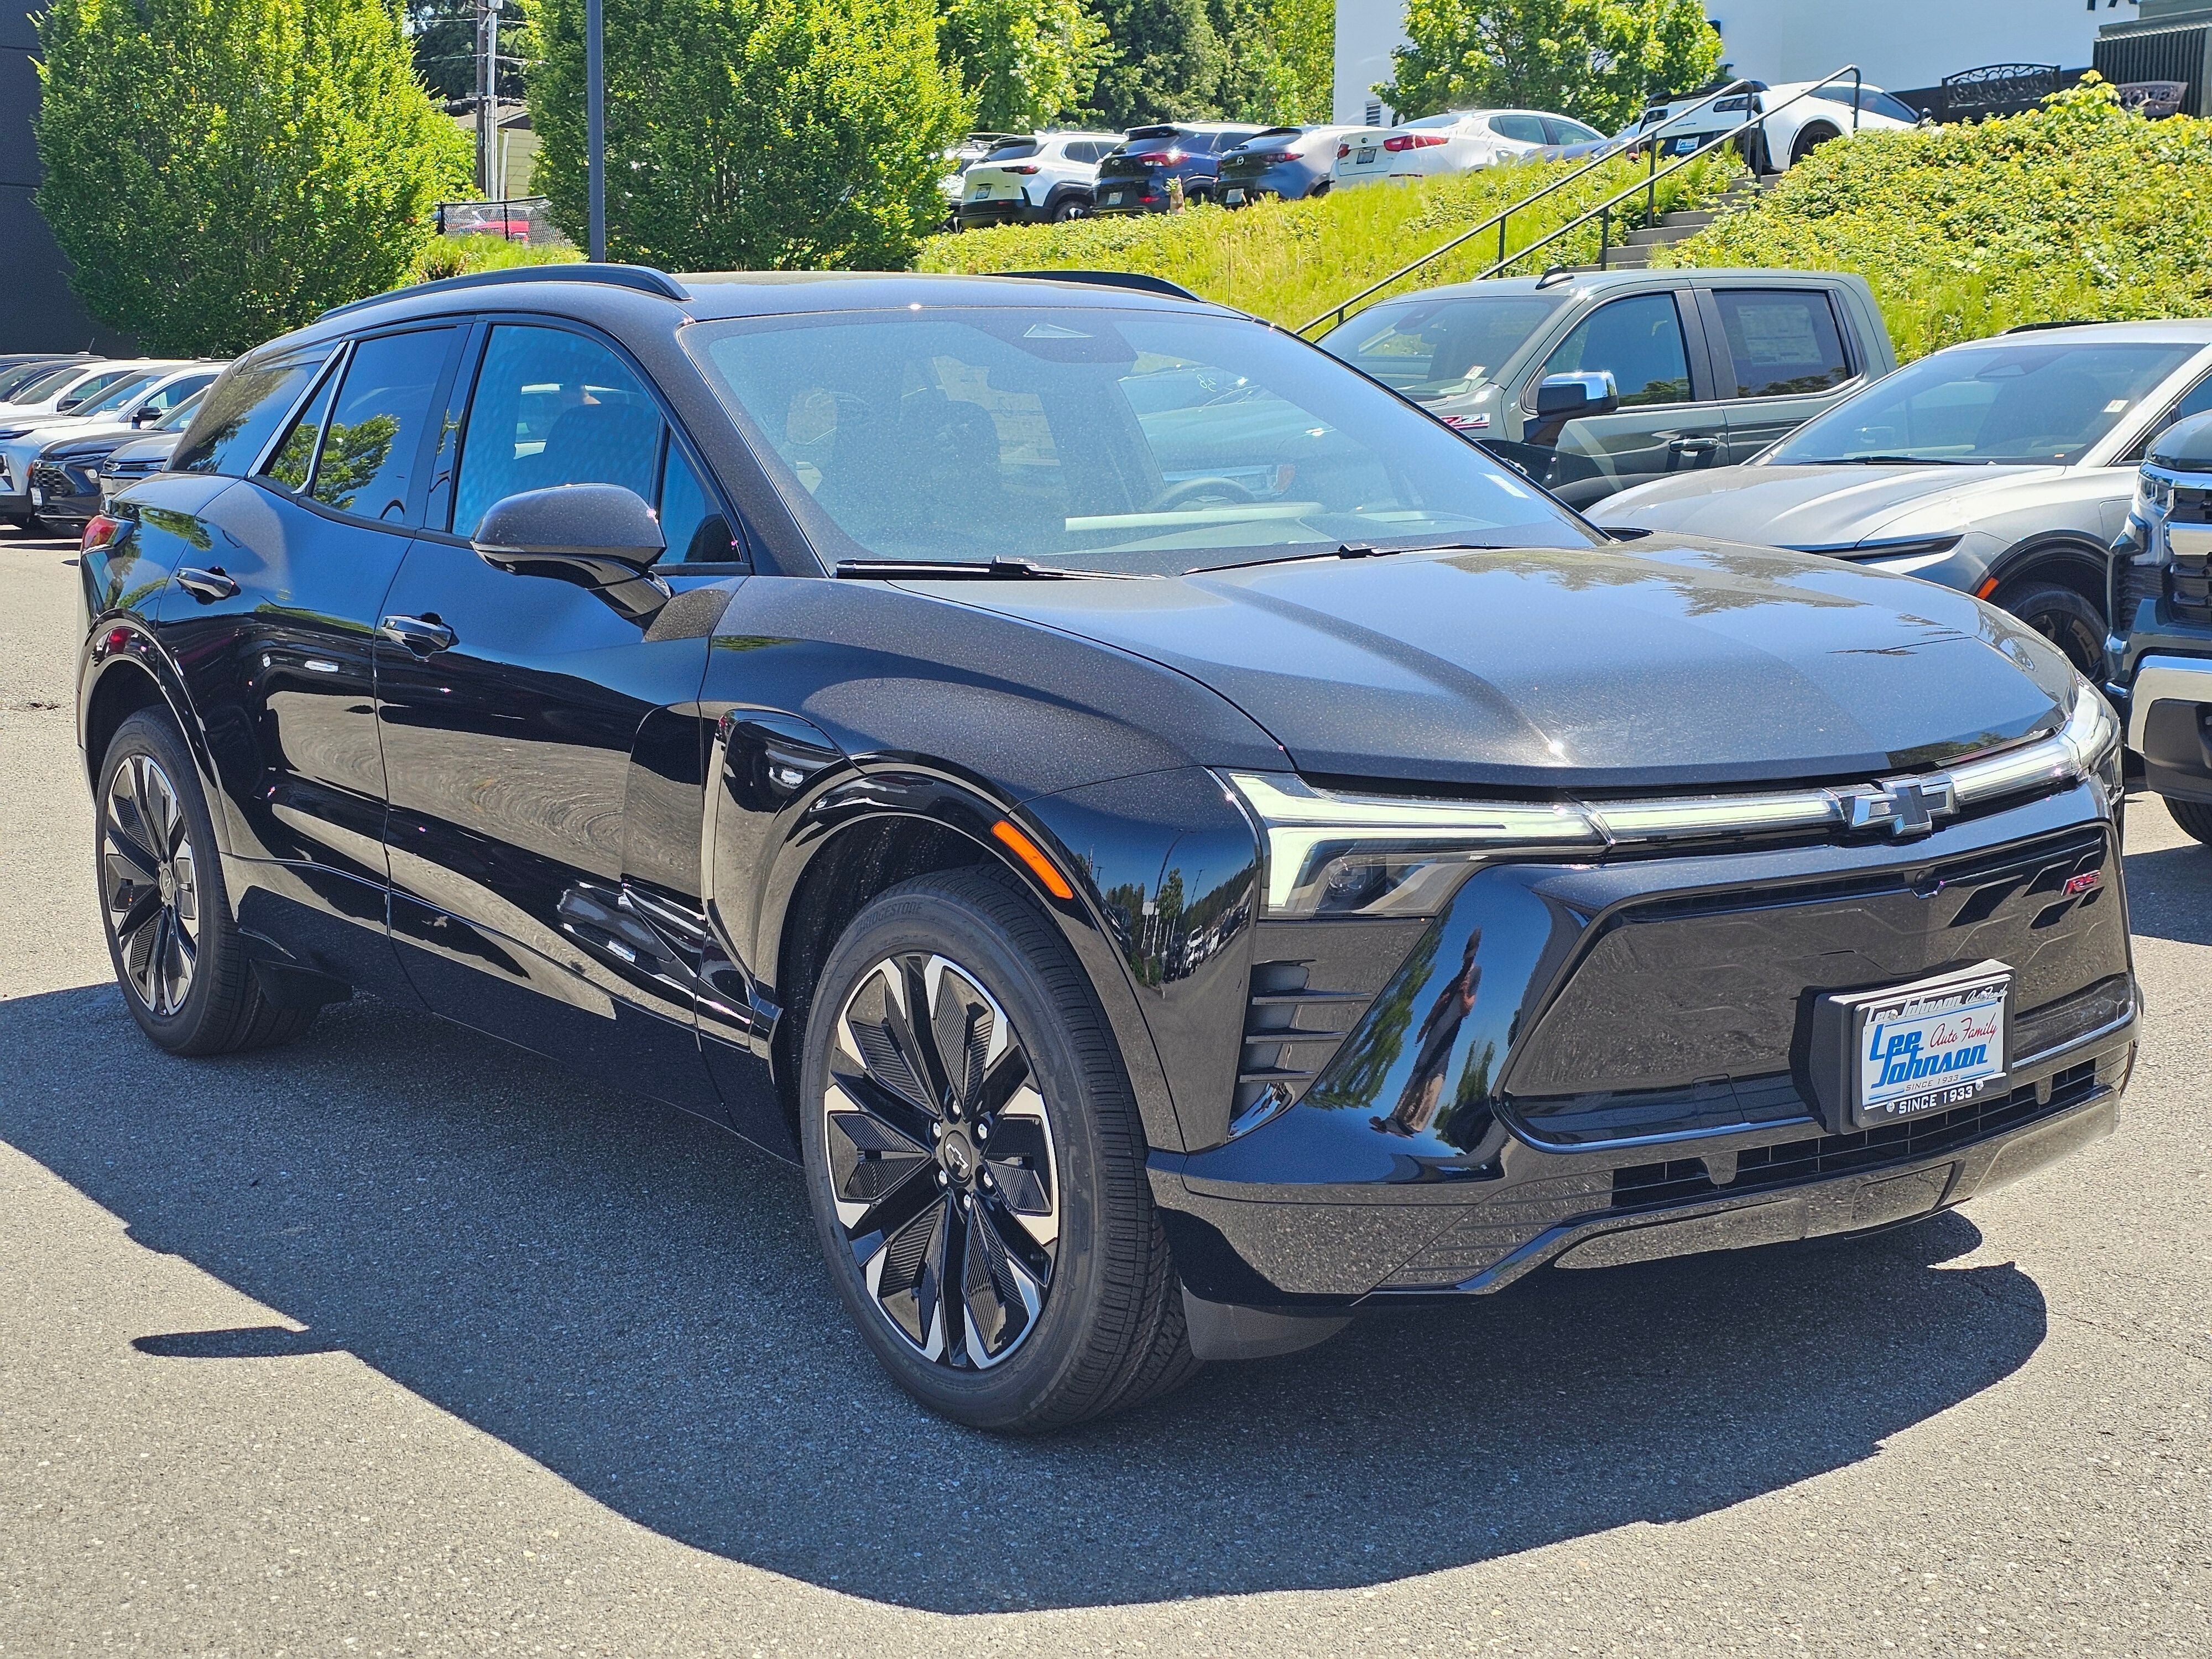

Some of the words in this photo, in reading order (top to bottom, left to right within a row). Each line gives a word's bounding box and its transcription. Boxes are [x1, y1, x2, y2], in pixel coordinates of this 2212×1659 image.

[1898, 995, 1962, 1018] Johnson
[1869, 1024, 1924, 1061] Lee
[1930, 1023, 1959, 1047] Auto
[1961, 1012, 1997, 1044] Family
[1871, 1044, 1988, 1089] Johnson
[1906, 1080, 1932, 1092] SINCE
[1937, 1074, 1959, 1084] 1933
[1898, 1094, 1937, 1114] SINCE
[1943, 1086, 1973, 1104] 1933
